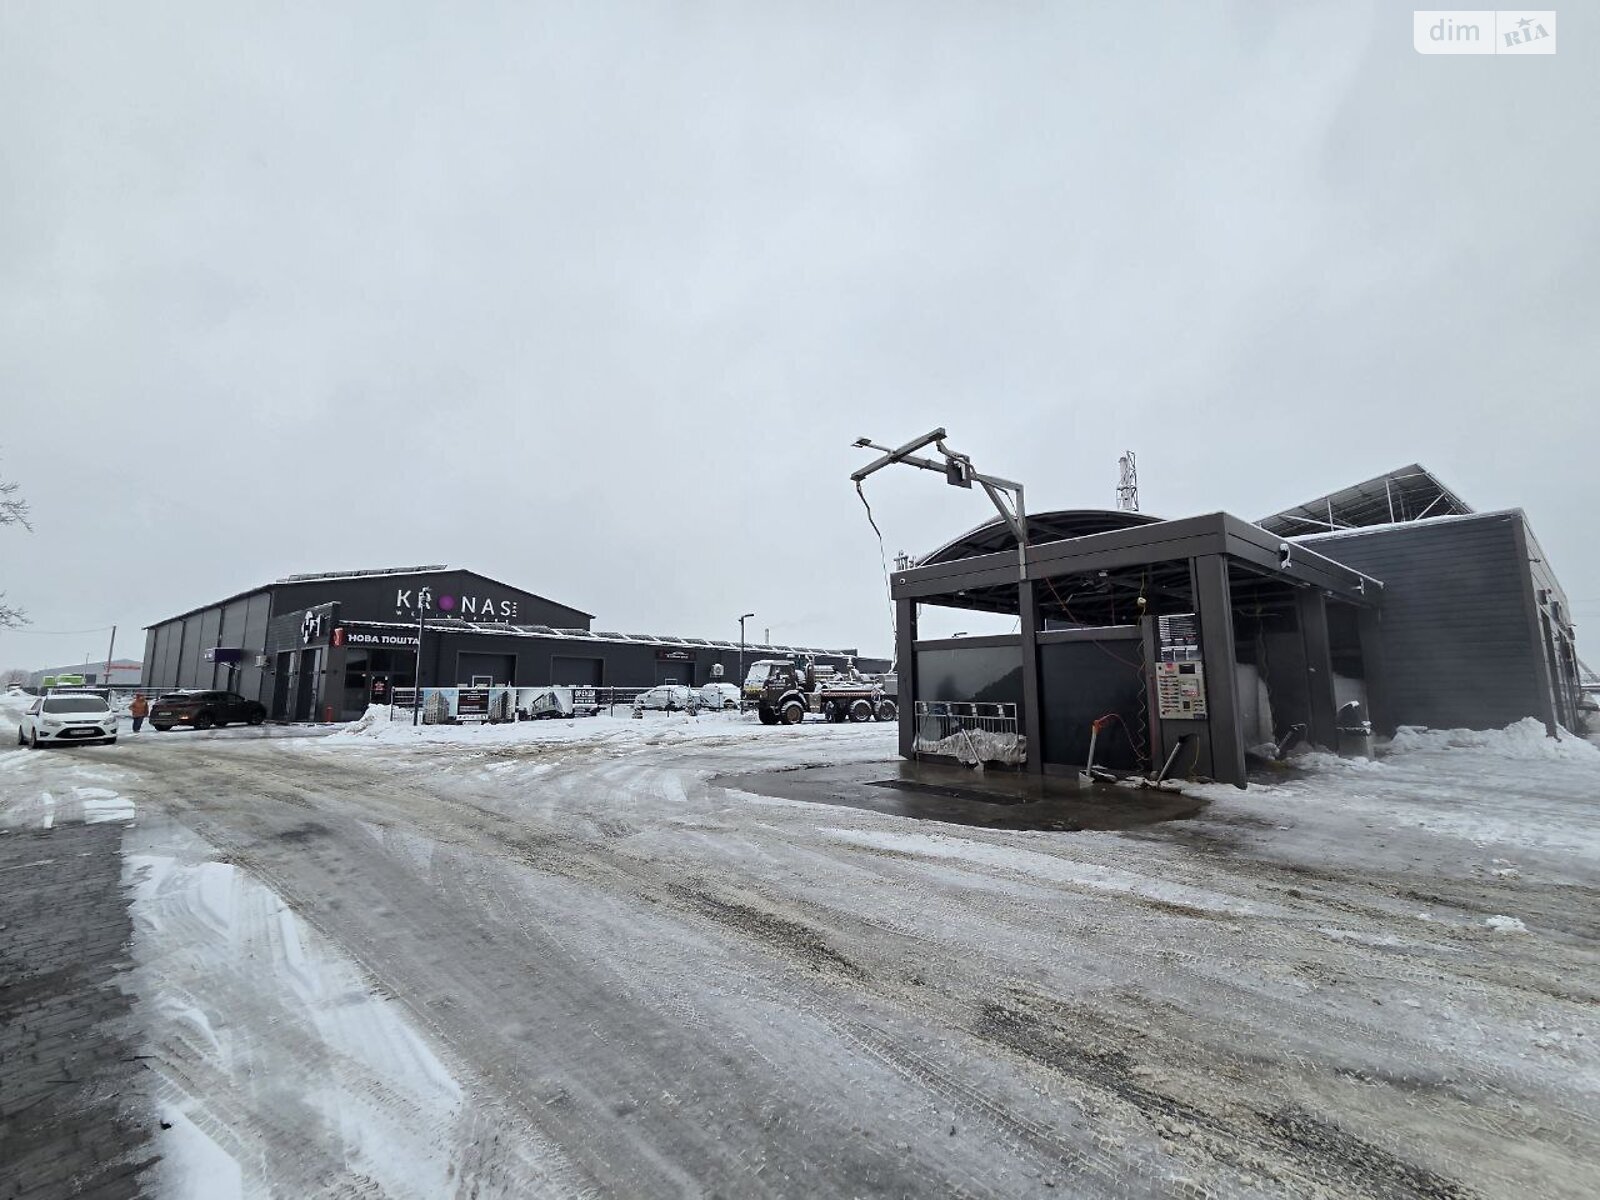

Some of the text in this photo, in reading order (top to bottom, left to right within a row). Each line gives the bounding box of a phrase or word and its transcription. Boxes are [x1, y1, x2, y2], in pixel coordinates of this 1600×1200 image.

[396, 589, 511, 616] KRONAS
[347, 633, 420, 645] НОВА ПОШТА
